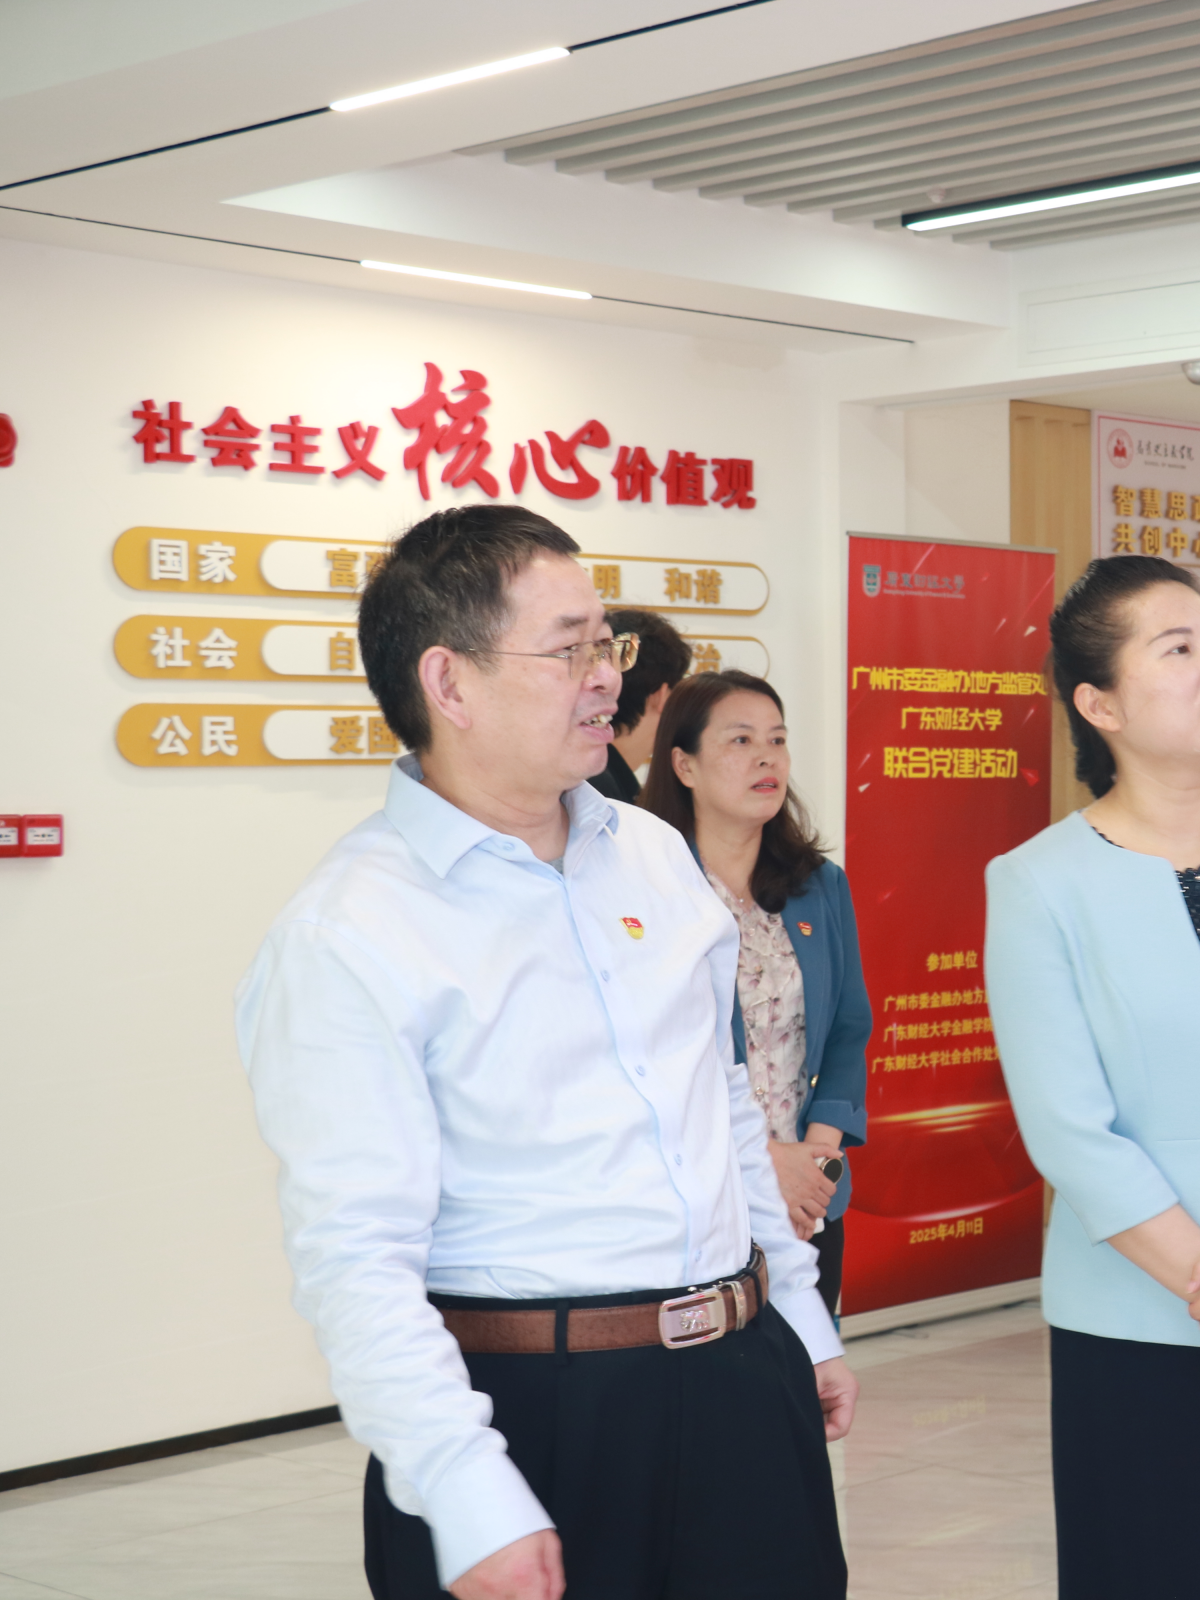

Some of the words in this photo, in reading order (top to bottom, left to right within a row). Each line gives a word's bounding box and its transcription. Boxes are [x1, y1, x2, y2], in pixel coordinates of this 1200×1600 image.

[131, 361, 757, 510] 社会主义核心价值观
[149, 537, 237, 583] 国家
[583, 564, 621, 600] 明
[663, 567, 723, 605] 和谐
[150, 626, 238, 669] 社会
[330, 631, 356, 672] 自
[151, 714, 239, 757] 公民
[329, 715, 399, 755] 爱国
[901, 706, 1003, 732] 广东财经大学
[883, 747, 1018, 779] 联合党建活动
[926, 951, 978, 973] 参加单位
[909, 1217, 984, 1244] 2025年4月11日
